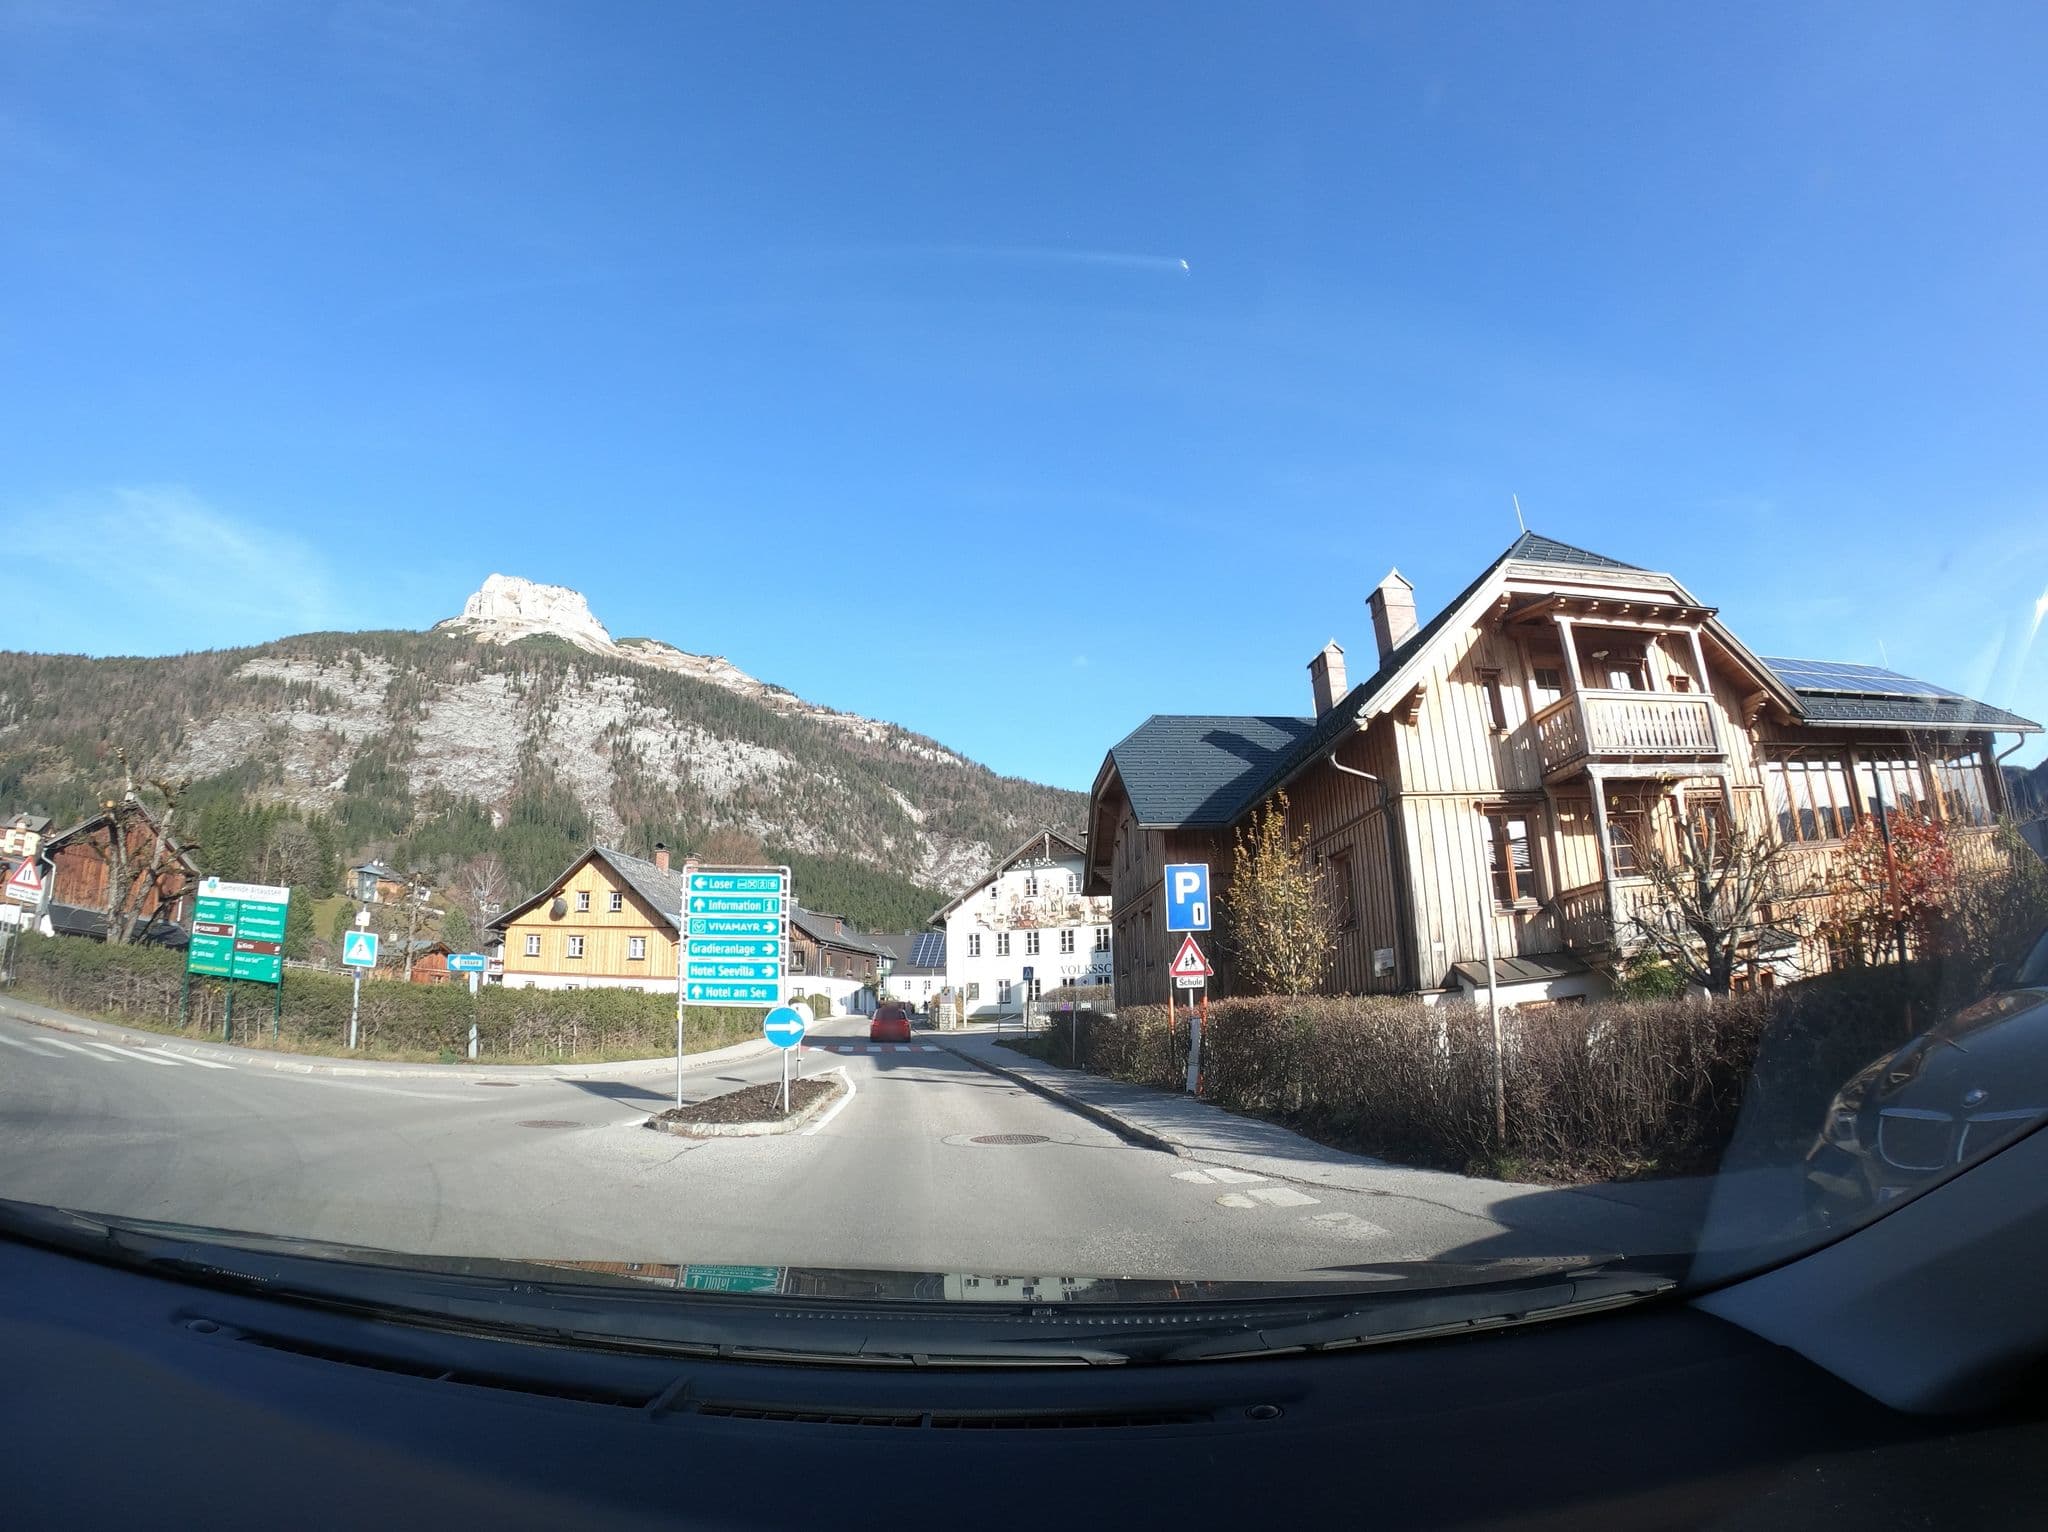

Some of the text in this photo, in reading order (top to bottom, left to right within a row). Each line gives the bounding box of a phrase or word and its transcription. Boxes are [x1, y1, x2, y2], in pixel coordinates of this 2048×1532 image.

[709, 878, 734, 889] Loser
[1175, 871, 1200, 905] P
[709, 899, 761, 911] Information
[708, 922, 760, 932] VIVAMAYR
[691, 943, 756, 956] Gradieranlage
[690, 965, 755, 977] Hotel Seevilla
[1179, 976, 1203, 986] Schule
[705, 986, 767, 998] Hotel am See
